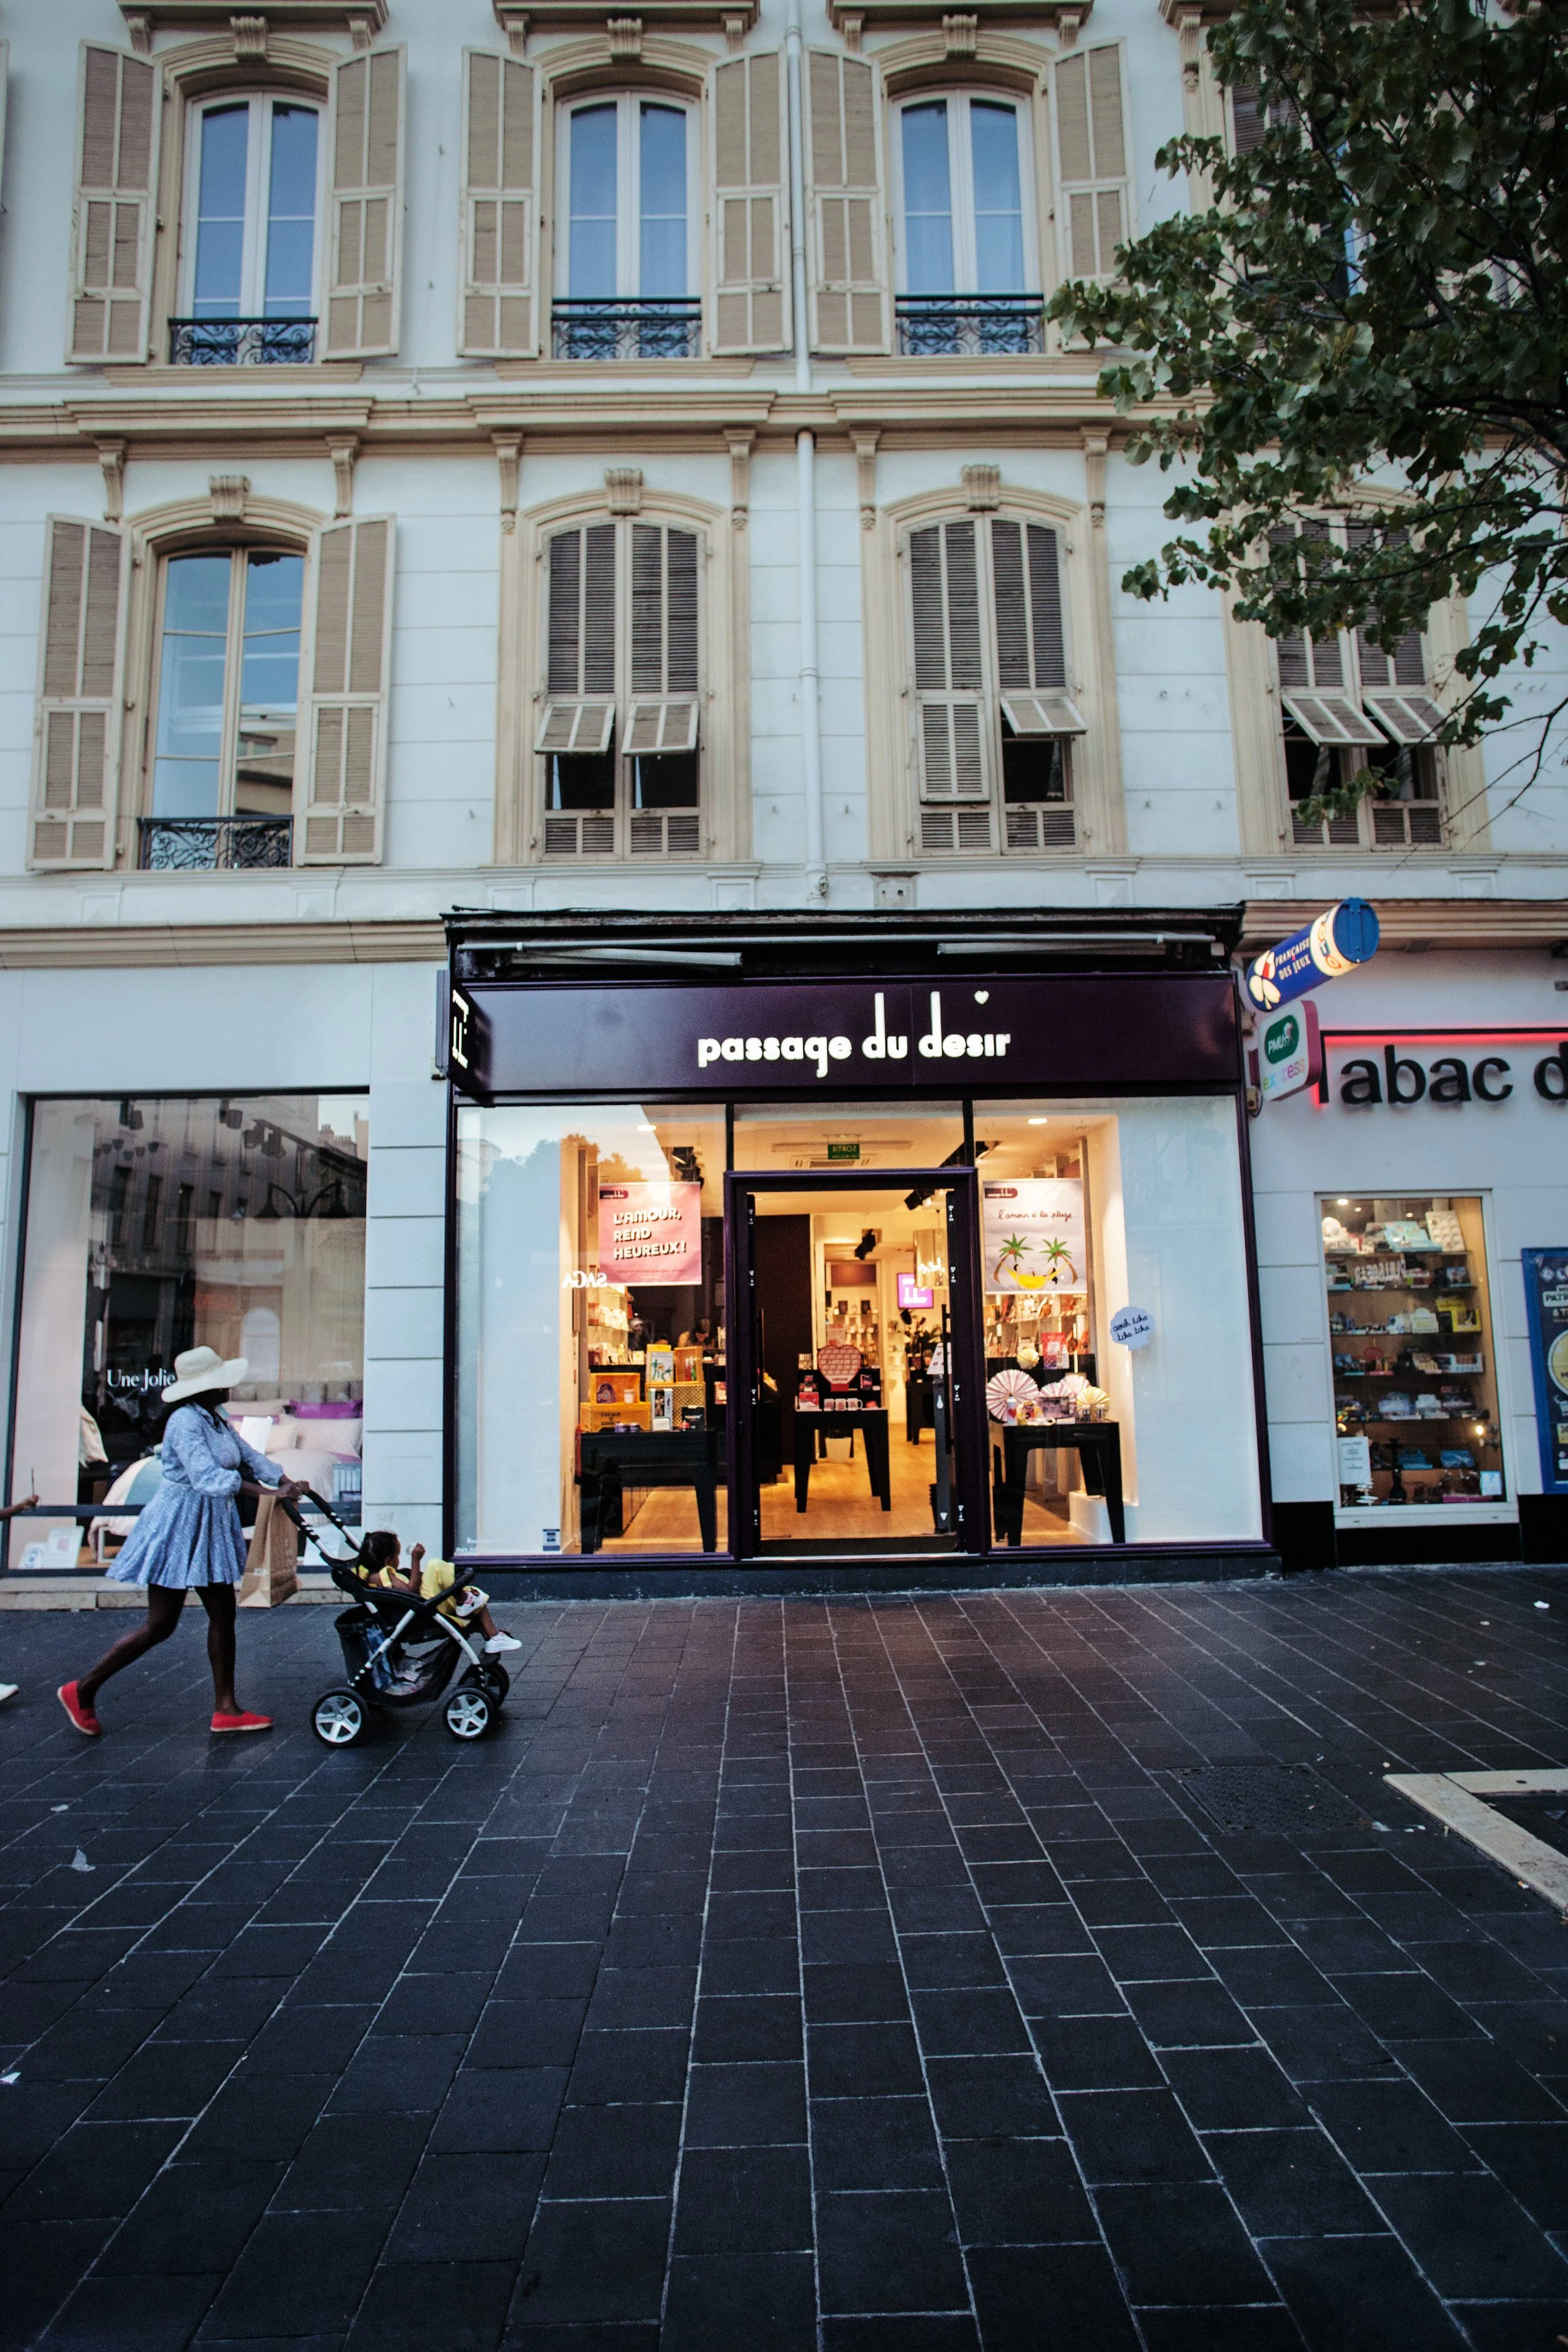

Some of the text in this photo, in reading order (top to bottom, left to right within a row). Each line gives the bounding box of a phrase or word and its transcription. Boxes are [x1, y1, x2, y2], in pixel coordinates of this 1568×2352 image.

[1275, 937, 1310, 967] FRANÇAISE
[1278, 953, 1311, 980] DES JEUX
[697, 1036, 852, 1078] passage
[861, 992, 908, 1059] du
[1268, 1036, 1285, 1055] PMU
[1263, 1058, 1305, 1091] exress
[1051, 1210, 1073, 1222] plage
[613, 1227, 652, 1243] REND
[107, 1367, 176, 1392] Une Jolie
